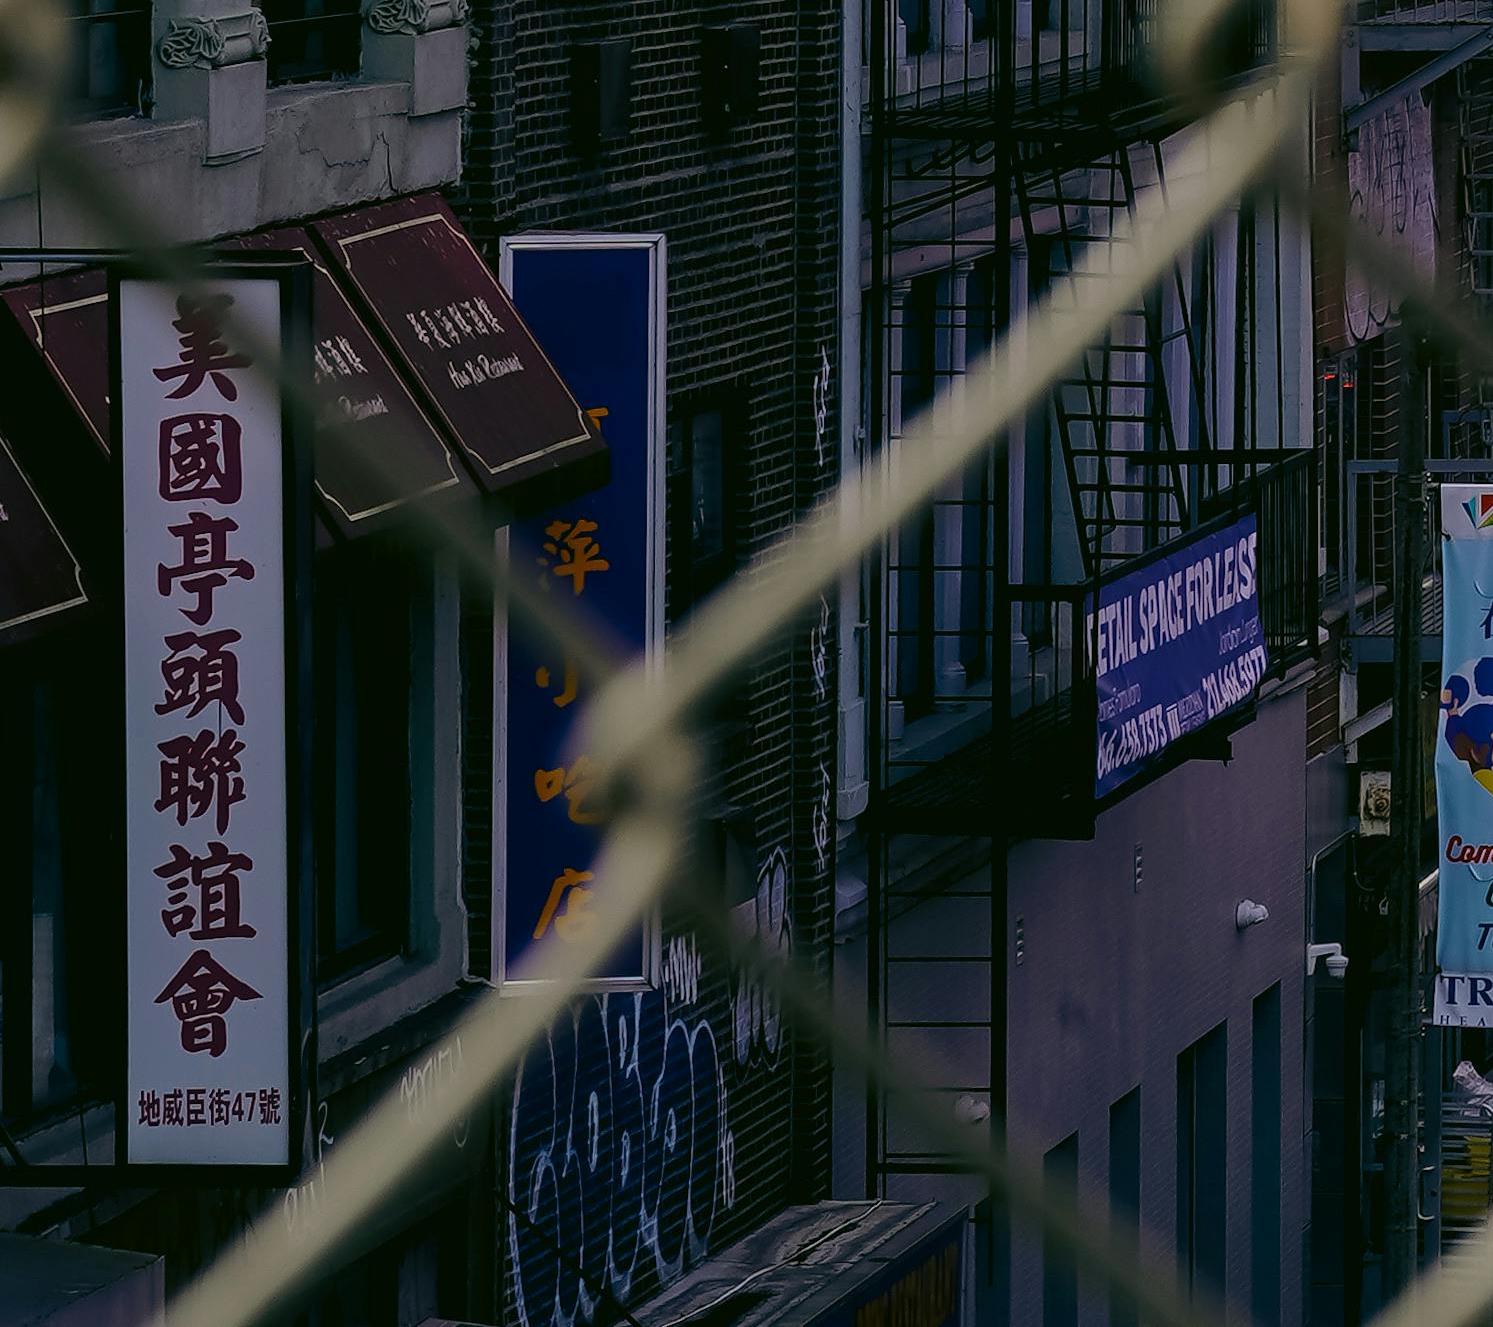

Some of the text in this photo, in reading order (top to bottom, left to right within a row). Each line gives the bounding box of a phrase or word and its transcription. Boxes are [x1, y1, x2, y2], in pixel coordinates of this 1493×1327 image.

[1139, 569, 1185, 655] SPACE
[1186, 555, 1216, 631] FOR
[152, 294, 265, 1061] 美國亭頭聯誼會
[138, 1089, 282, 1129] 地威臣街47號
